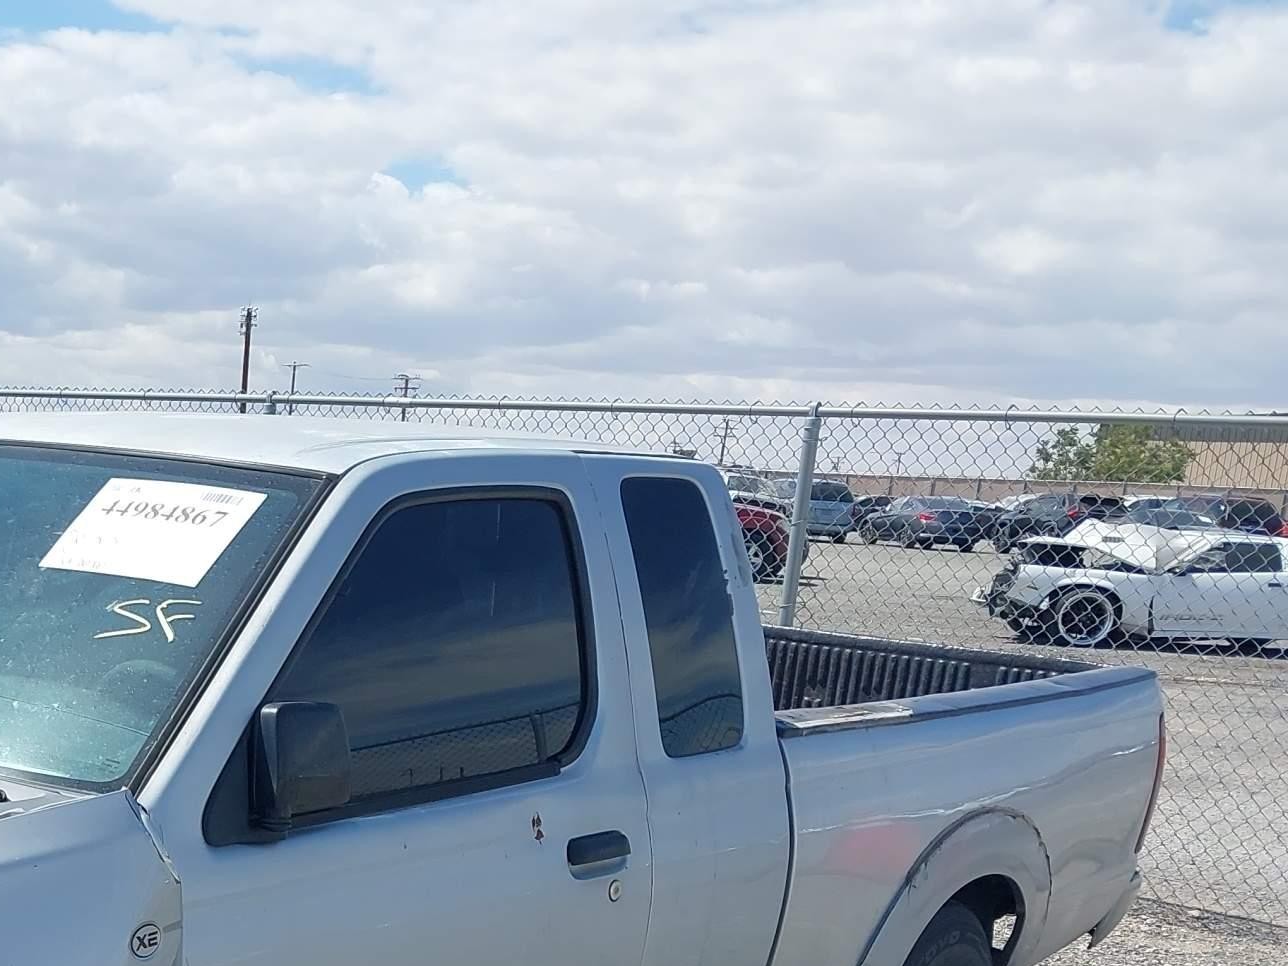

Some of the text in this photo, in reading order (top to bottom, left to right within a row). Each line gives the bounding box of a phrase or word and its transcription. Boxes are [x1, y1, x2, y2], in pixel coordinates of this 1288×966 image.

[102, 499, 229, 527] 44984867
[92, 599, 203, 643] SF
[135, 930, 159, 952] XE
